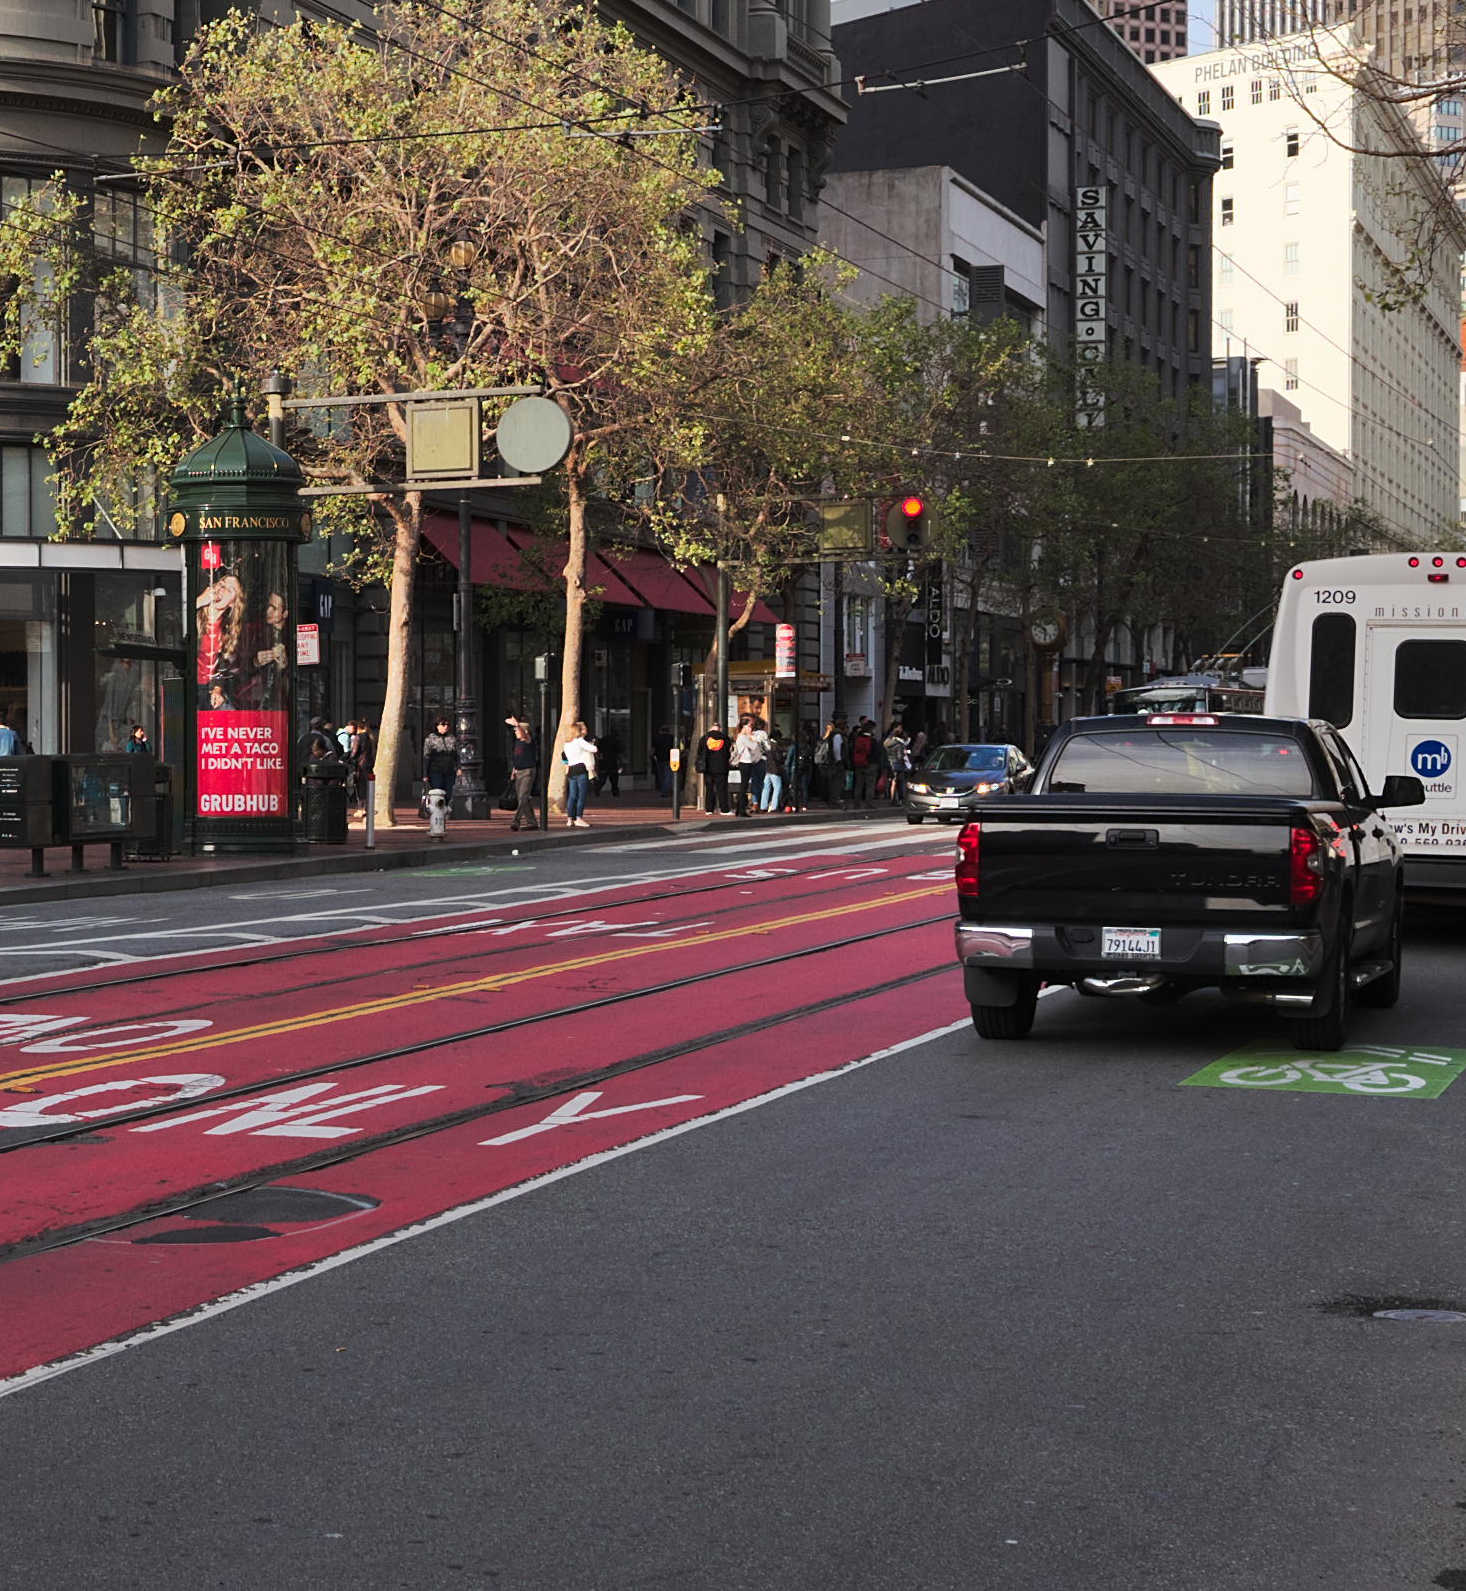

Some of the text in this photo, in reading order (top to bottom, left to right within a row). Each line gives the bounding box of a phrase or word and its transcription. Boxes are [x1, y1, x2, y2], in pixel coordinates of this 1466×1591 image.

[1195, 44, 1317, 84] PHELAN BUILDING
[1079, 188, 1102, 318] SAVING
[199, 516, 289, 529] SAN FRANCISCO
[1314, 590, 1357, 604] 1209
[320, 594, 332, 618] GAP
[929, 587, 942, 638] ALDO
[614, 618, 633, 632] GAP
[927, 664, 949, 686] ALDO
[201, 727, 272, 739] I'VE NEVER
[201, 742, 279, 754] MET A TACO
[201, 758, 205, 769] I
[257, 758, 284, 770] LIKE.
[1425, 783, 1452, 792] uttle
[200, 794, 278, 812] GRUBHUB
[1418, 823, 1437, 837] My
[1169, 872, 1281, 888] TUNDRA
[1106, 938, 1156, 953] 79144J1
